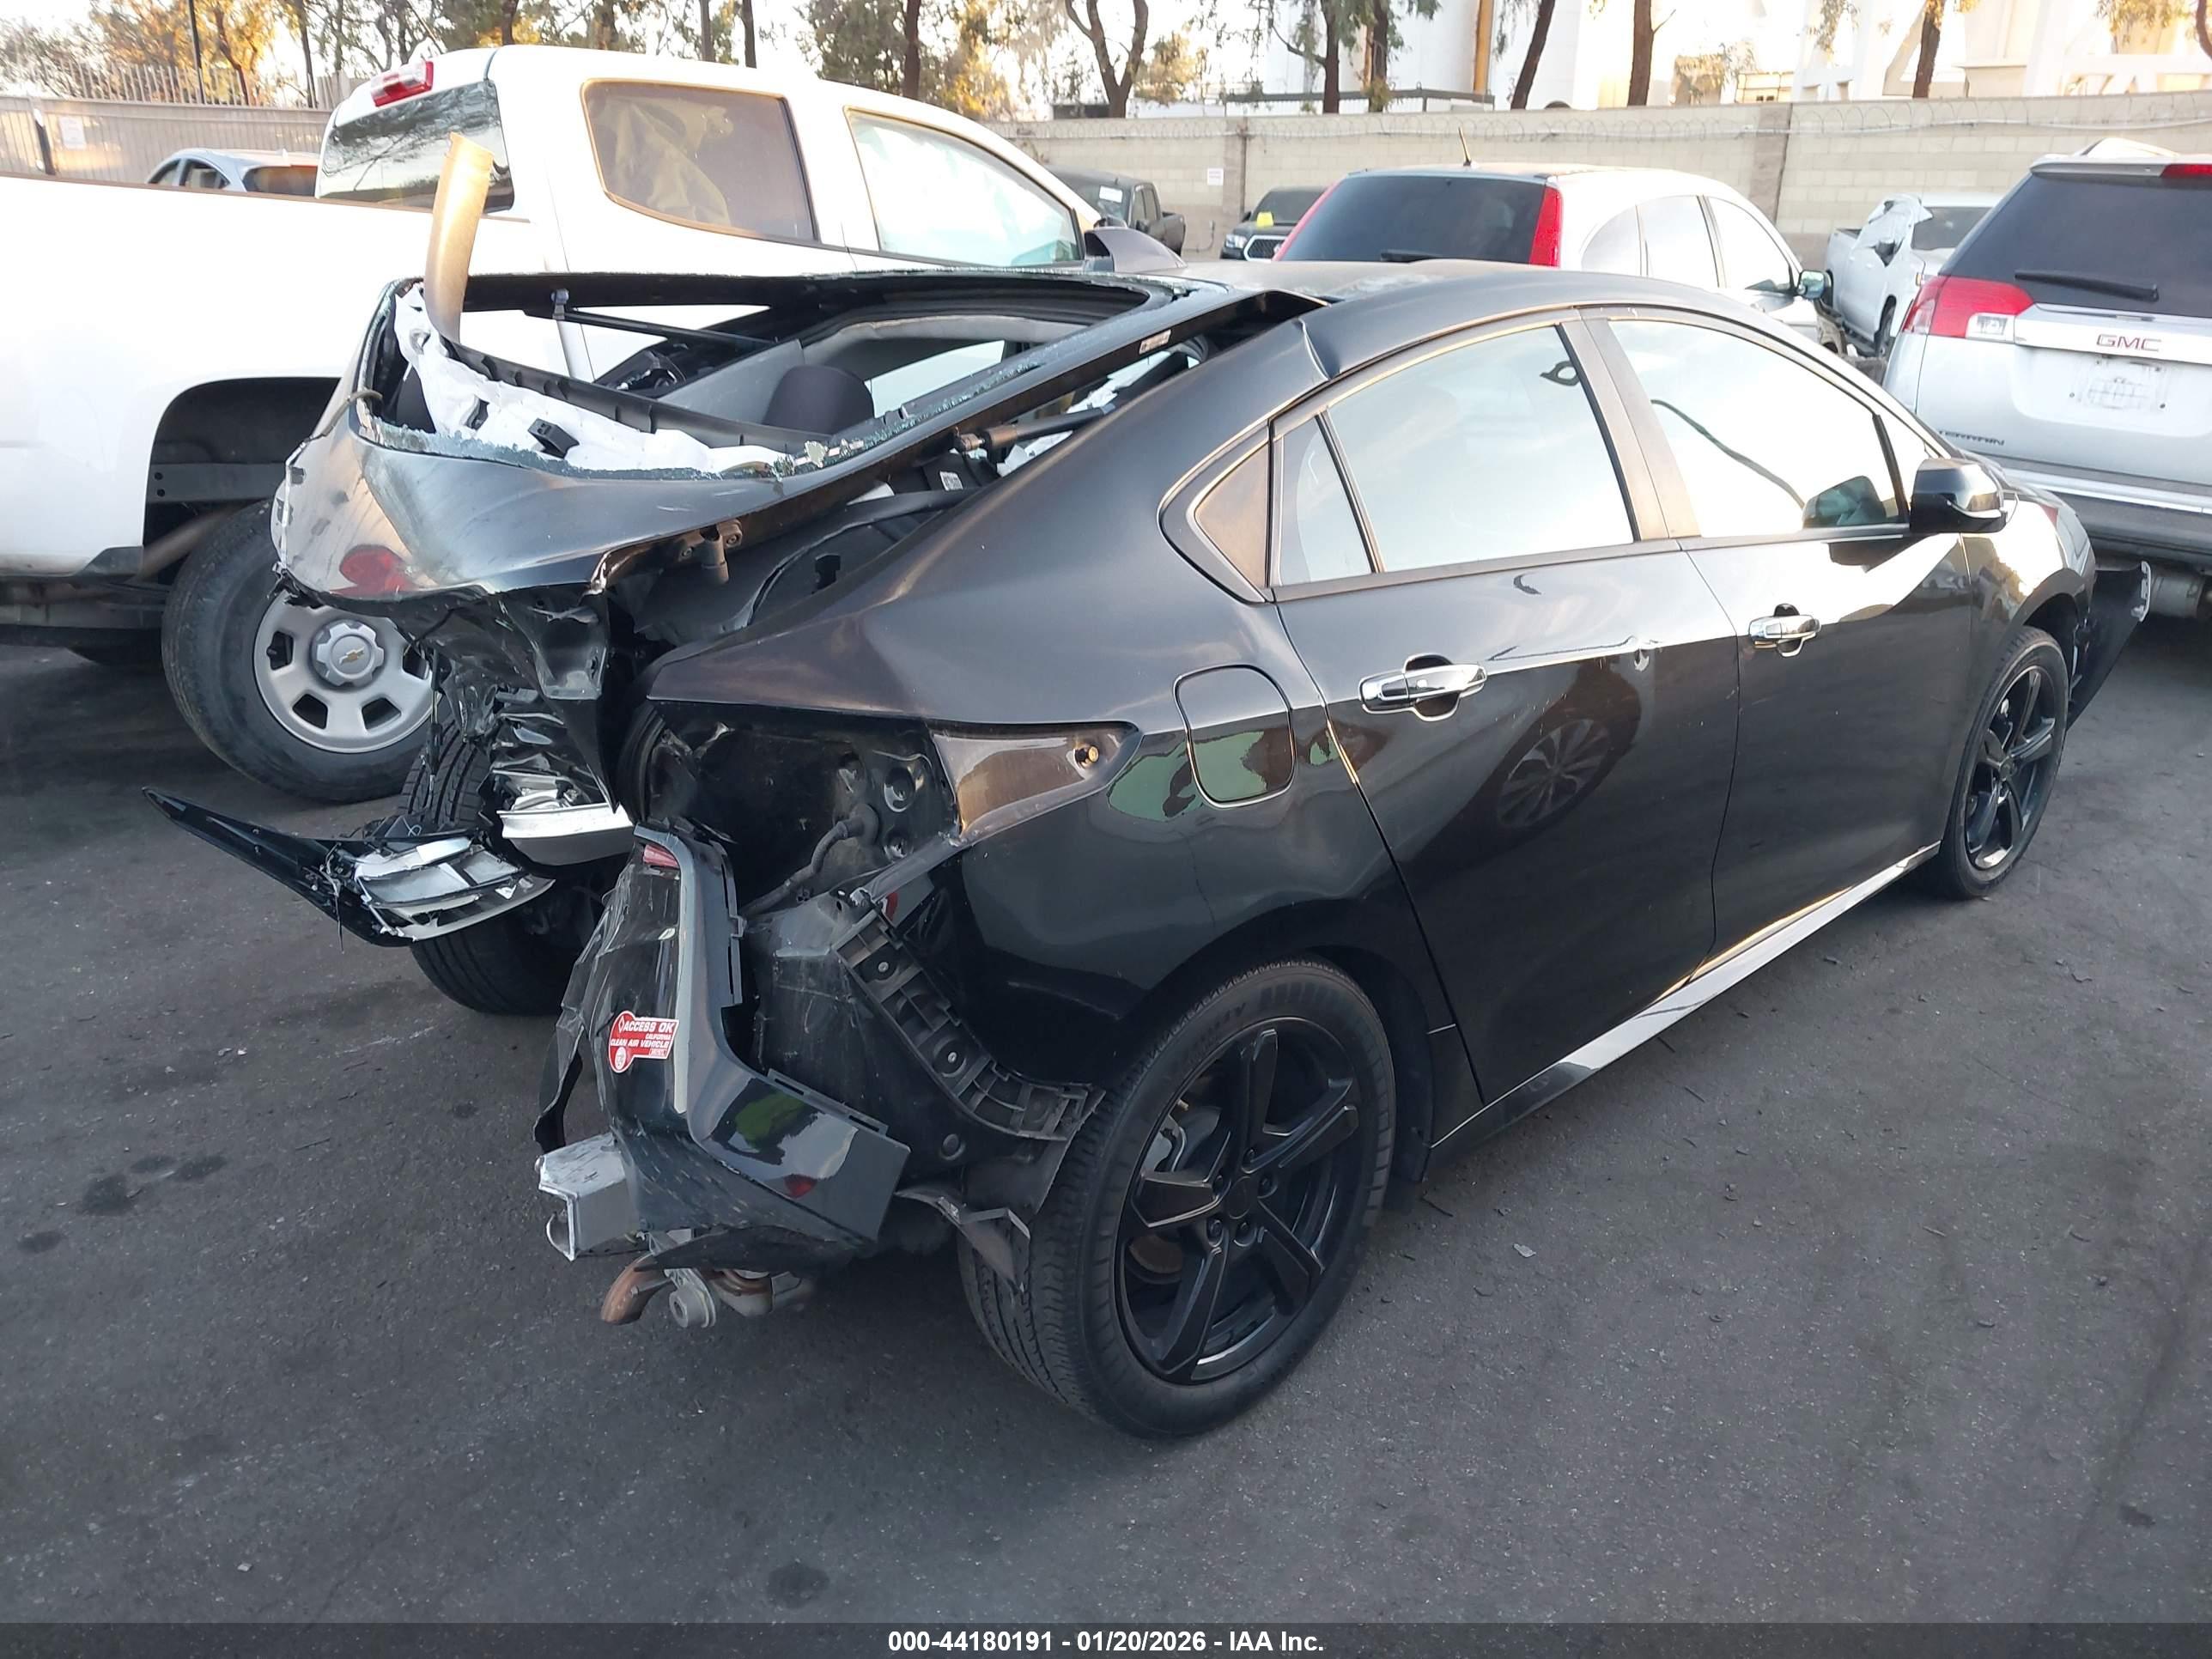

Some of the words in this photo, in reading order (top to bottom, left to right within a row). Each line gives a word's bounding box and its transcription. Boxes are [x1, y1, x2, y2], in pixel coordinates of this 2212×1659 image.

[2096, 333, 2162, 352] GMC
[623, 1021, 657, 1032] ACCESS
[659, 1023, 674, 1033] OK
[628, 1039, 640, 1048] AIR
